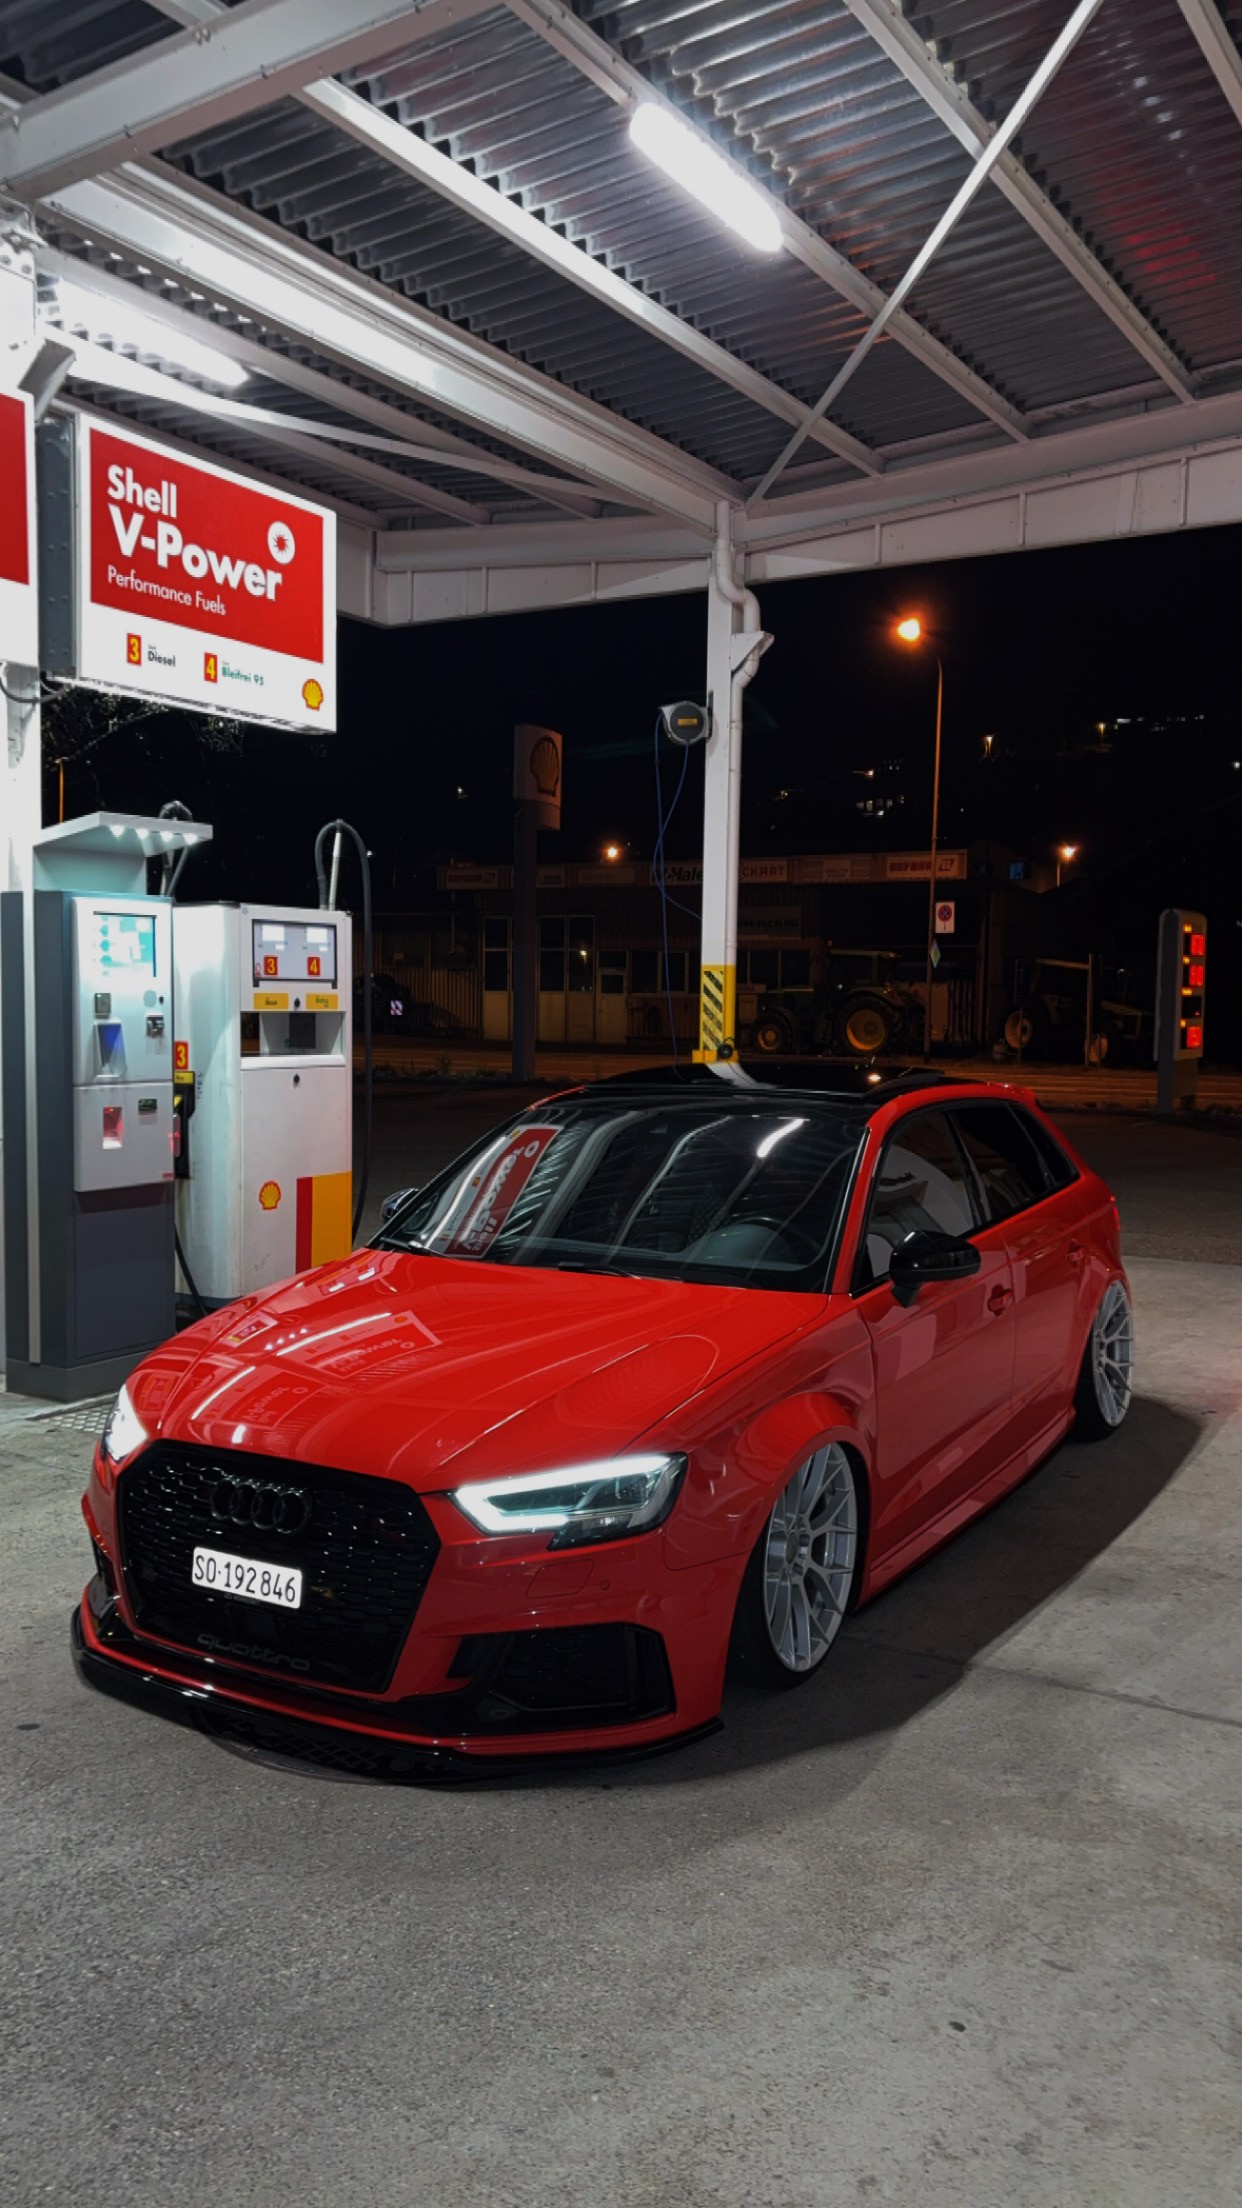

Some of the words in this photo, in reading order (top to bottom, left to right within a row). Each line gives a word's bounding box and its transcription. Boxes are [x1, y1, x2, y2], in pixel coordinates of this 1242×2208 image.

[108, 464, 177, 519] Shell
[108, 504, 282, 602] V-Power
[108, 565, 192, 606] Performance
[196, 591, 226, 616] Fuels
[130, 637, 139, 661] 3
[148, 651, 175, 667] Diesel
[207, 657, 216, 679] 4
[740, 866, 785, 878] CKART
[267, 958, 276, 974] 3
[310, 958, 318, 974] 4
[177, 1045, 186, 1067] 3
[197, 1633, 311, 1671] quattro
